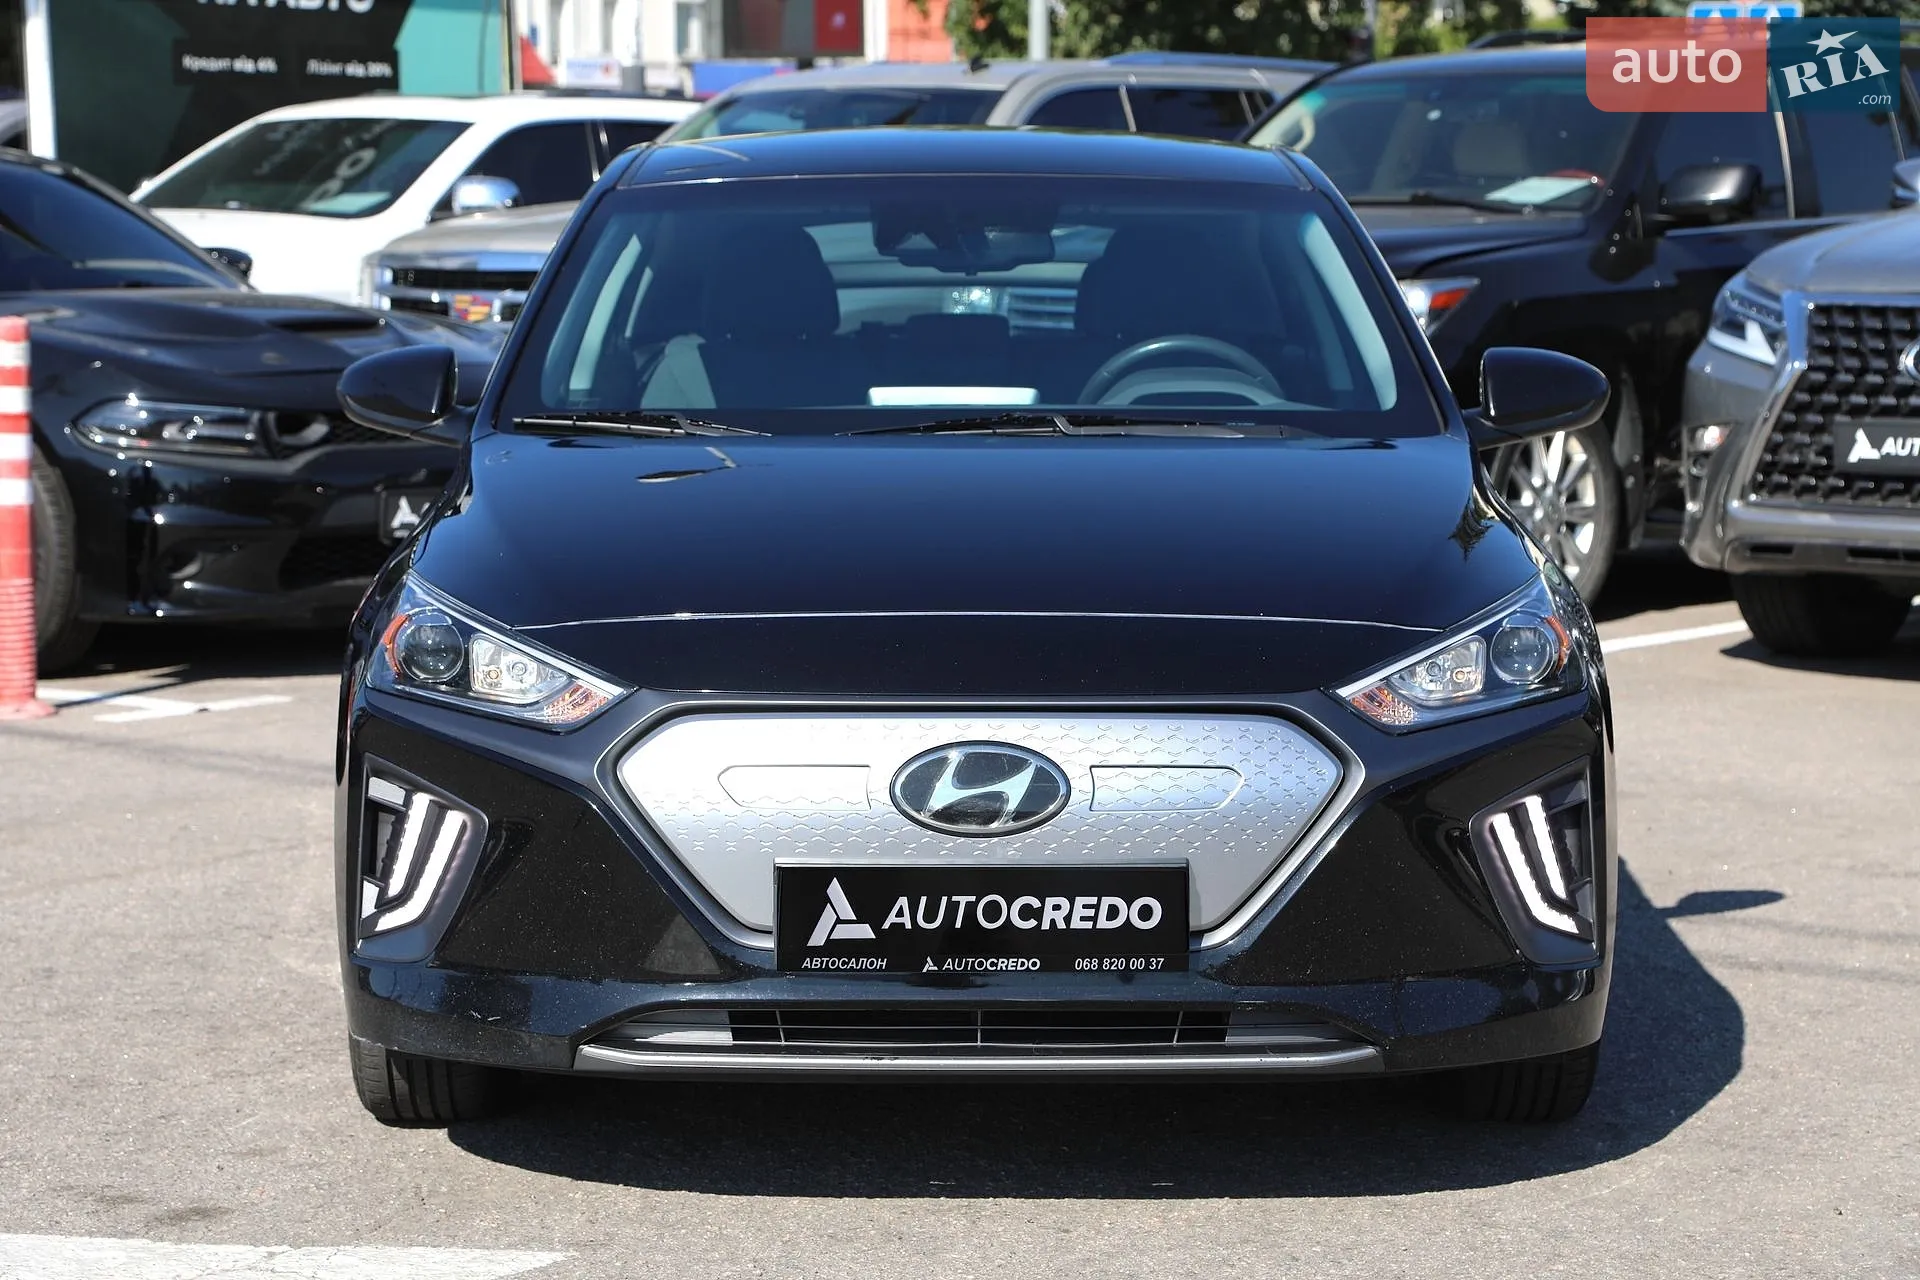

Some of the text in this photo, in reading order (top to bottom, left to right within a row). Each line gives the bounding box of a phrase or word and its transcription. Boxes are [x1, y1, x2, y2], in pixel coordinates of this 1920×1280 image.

[881, 894, 1162, 930] AUTOCREDO
[801, 957, 887, 970] АВТОСАЛОН
[942, 958, 1041, 971] AUTOCREDO
[1074, 957, 1165, 970] 068 820 00 37
